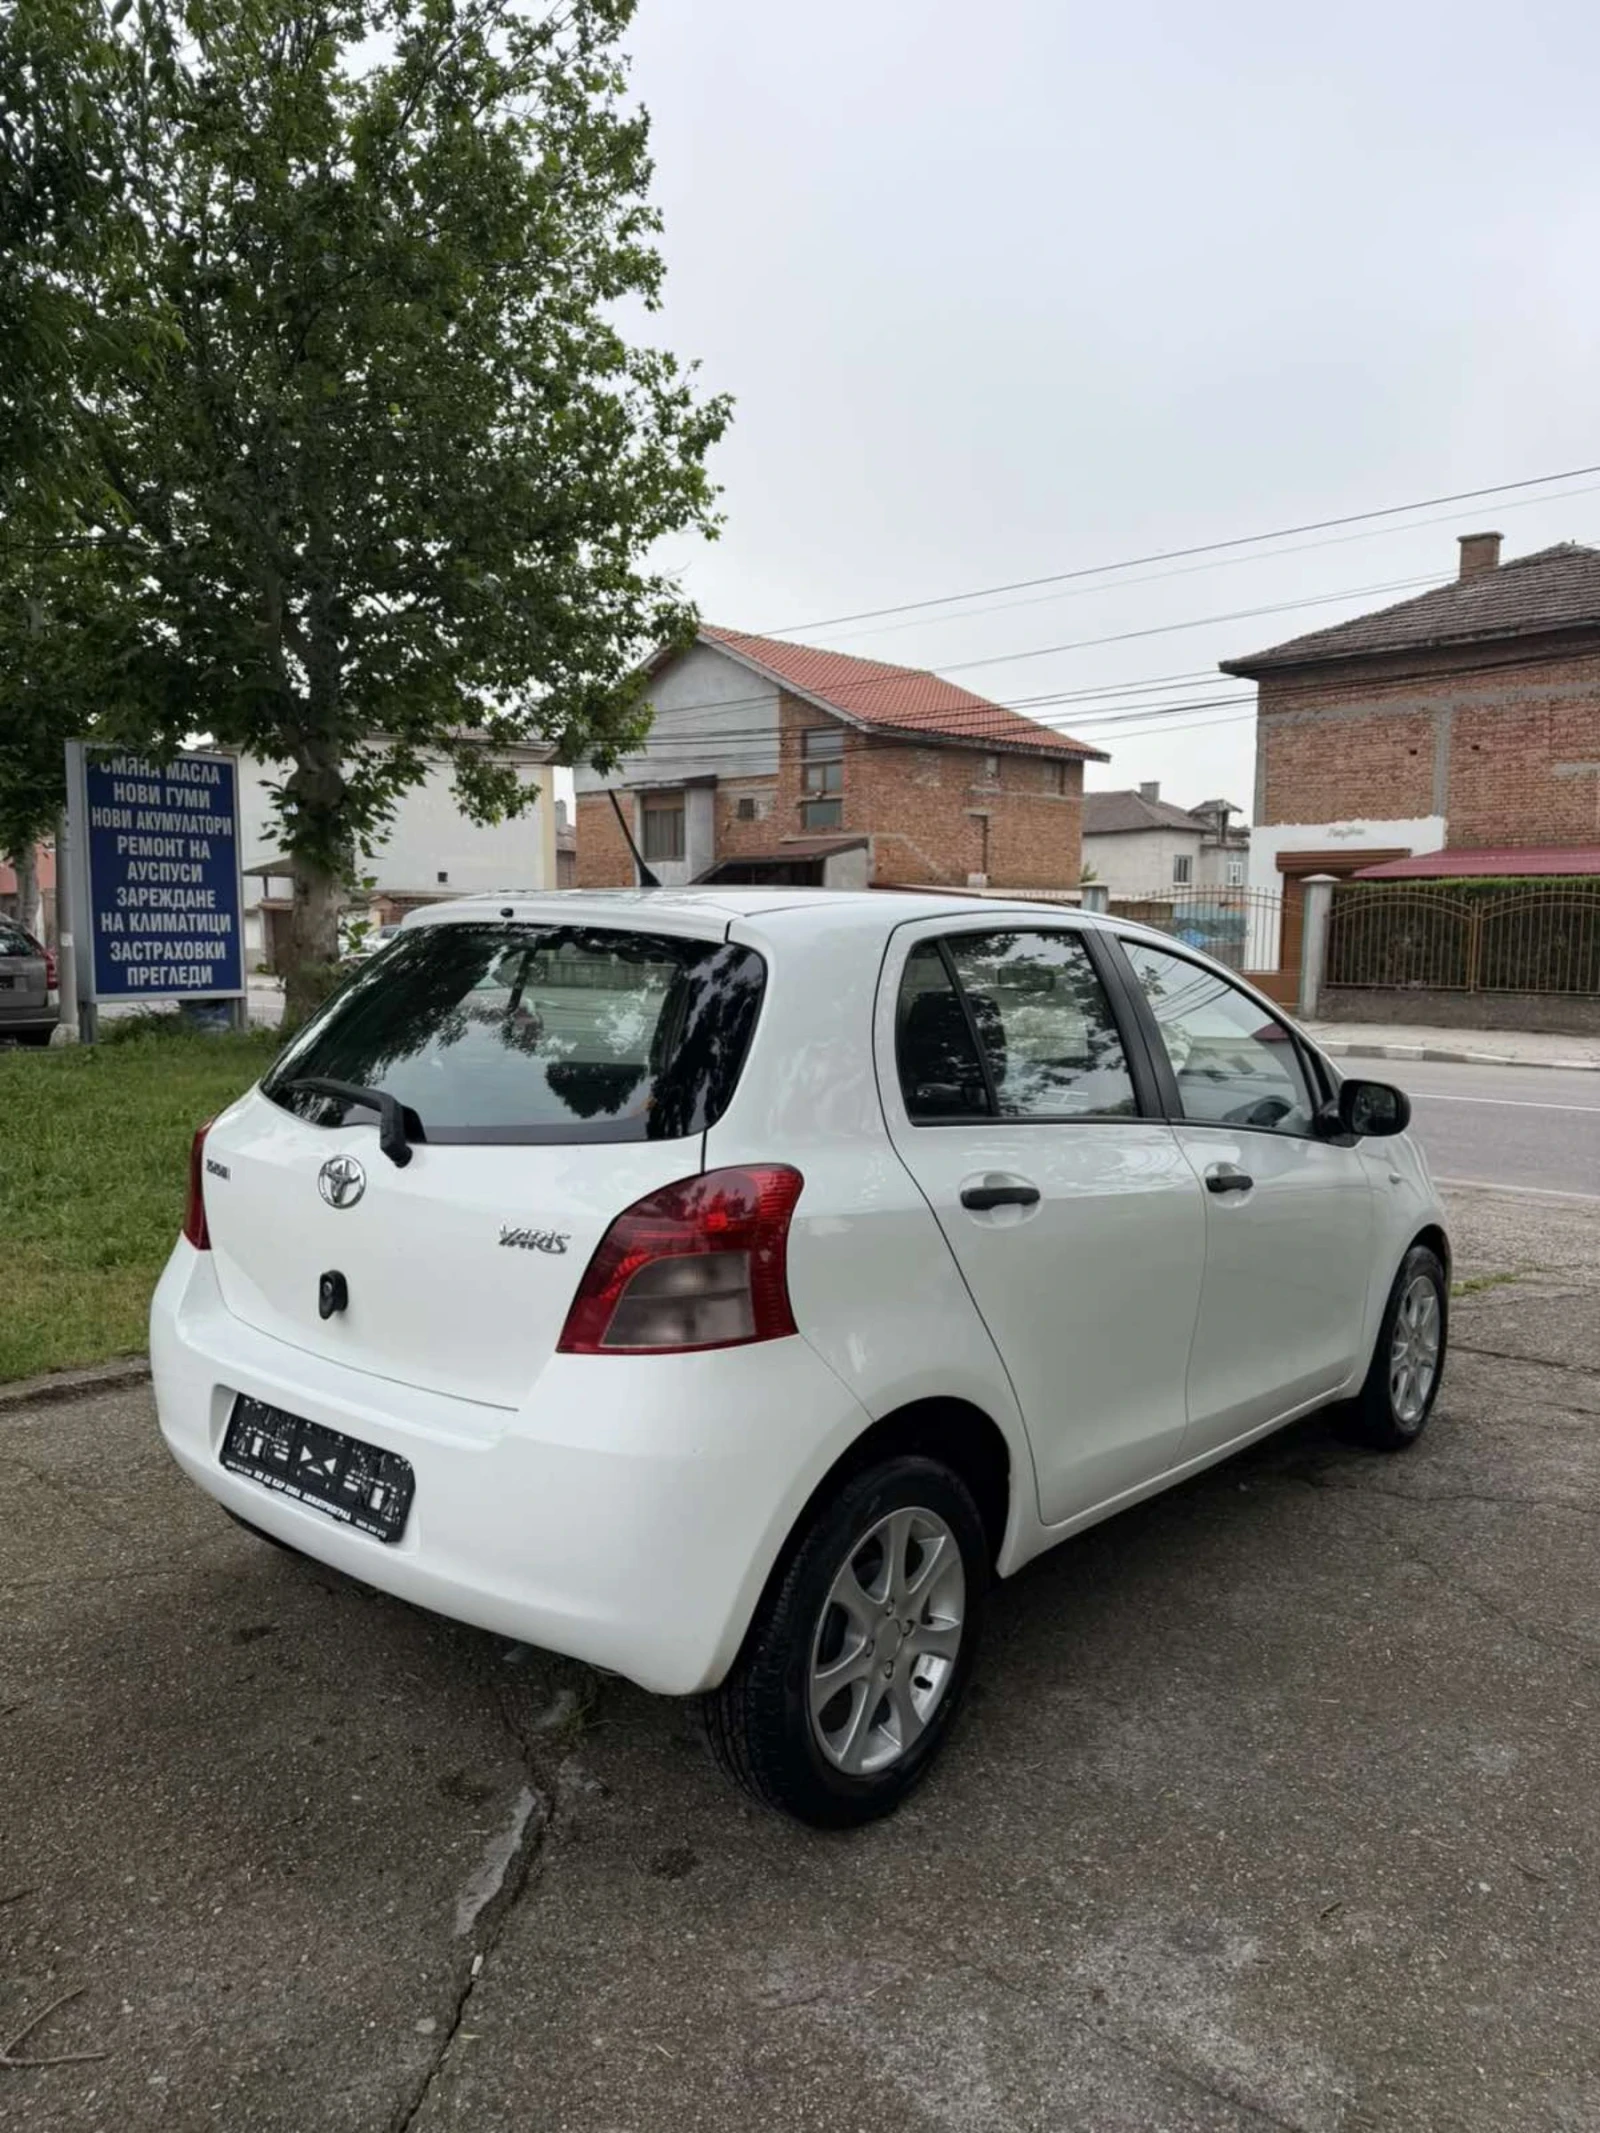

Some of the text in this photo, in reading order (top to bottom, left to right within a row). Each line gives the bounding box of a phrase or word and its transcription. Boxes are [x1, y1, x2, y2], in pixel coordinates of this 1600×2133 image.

[166, 765, 220, 785] МАСЛА
[114, 782, 210, 809] НОВИ ГУМИ
[92, 807, 232, 836] НОВИ АКУМУЛАТОРИ
[117, 835, 211, 859] РЕМОНТ НА
[127, 861, 203, 883] АУСПУСИ
[117, 887, 216, 911] ЗАРЕЖДАНЕ
[101, 913, 231, 936] НА КЛИМАТИЦИ
[110, 941, 226, 961] ЗАСТРАХОВКИ
[127, 966, 213, 988] ПРЕГЛЕДИ
[499, 1225, 572, 1255] YARIS
